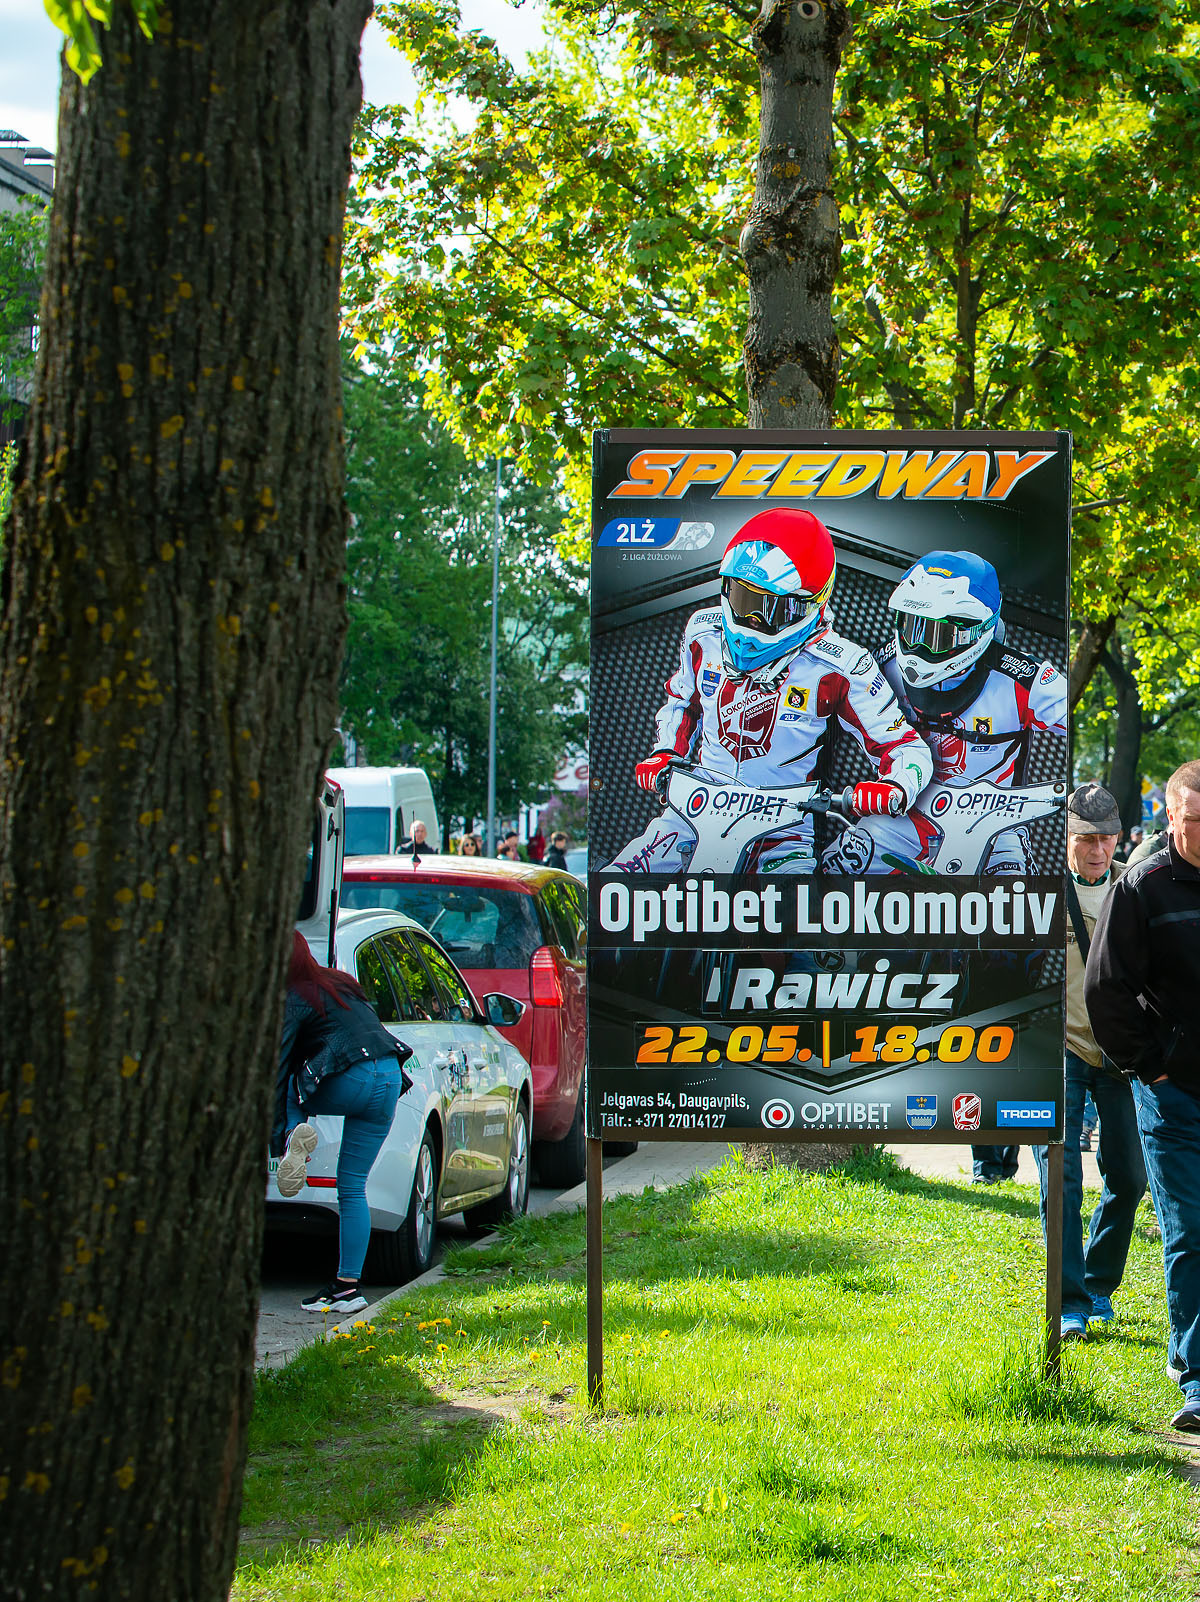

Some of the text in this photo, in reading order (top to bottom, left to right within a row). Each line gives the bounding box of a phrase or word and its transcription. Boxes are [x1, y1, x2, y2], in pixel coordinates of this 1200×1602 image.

[607, 449, 1058, 500] SPEEDWAY
[616, 519, 655, 543] 2LŻ
[630, 553, 646, 561] LIGA
[712, 789, 788, 817] OPTIBET
[956, 792, 1029, 814] OPTIBET
[599, 880, 1057, 942] Optibet Lokomotiv
[729, 958, 960, 1010] Rawicz
[635, 1024, 813, 1064] 22.05.
[849, 1024, 1015, 1064] 18.00
[600, 1092, 750, 1111] Jelgavas 54, Daugavpils,
[800, 1102, 892, 1123] OPTIBET
[600, 1112, 726, 1128] Tālr.: +371 27014127
[1000, 1109, 1052, 1119] TRODO
